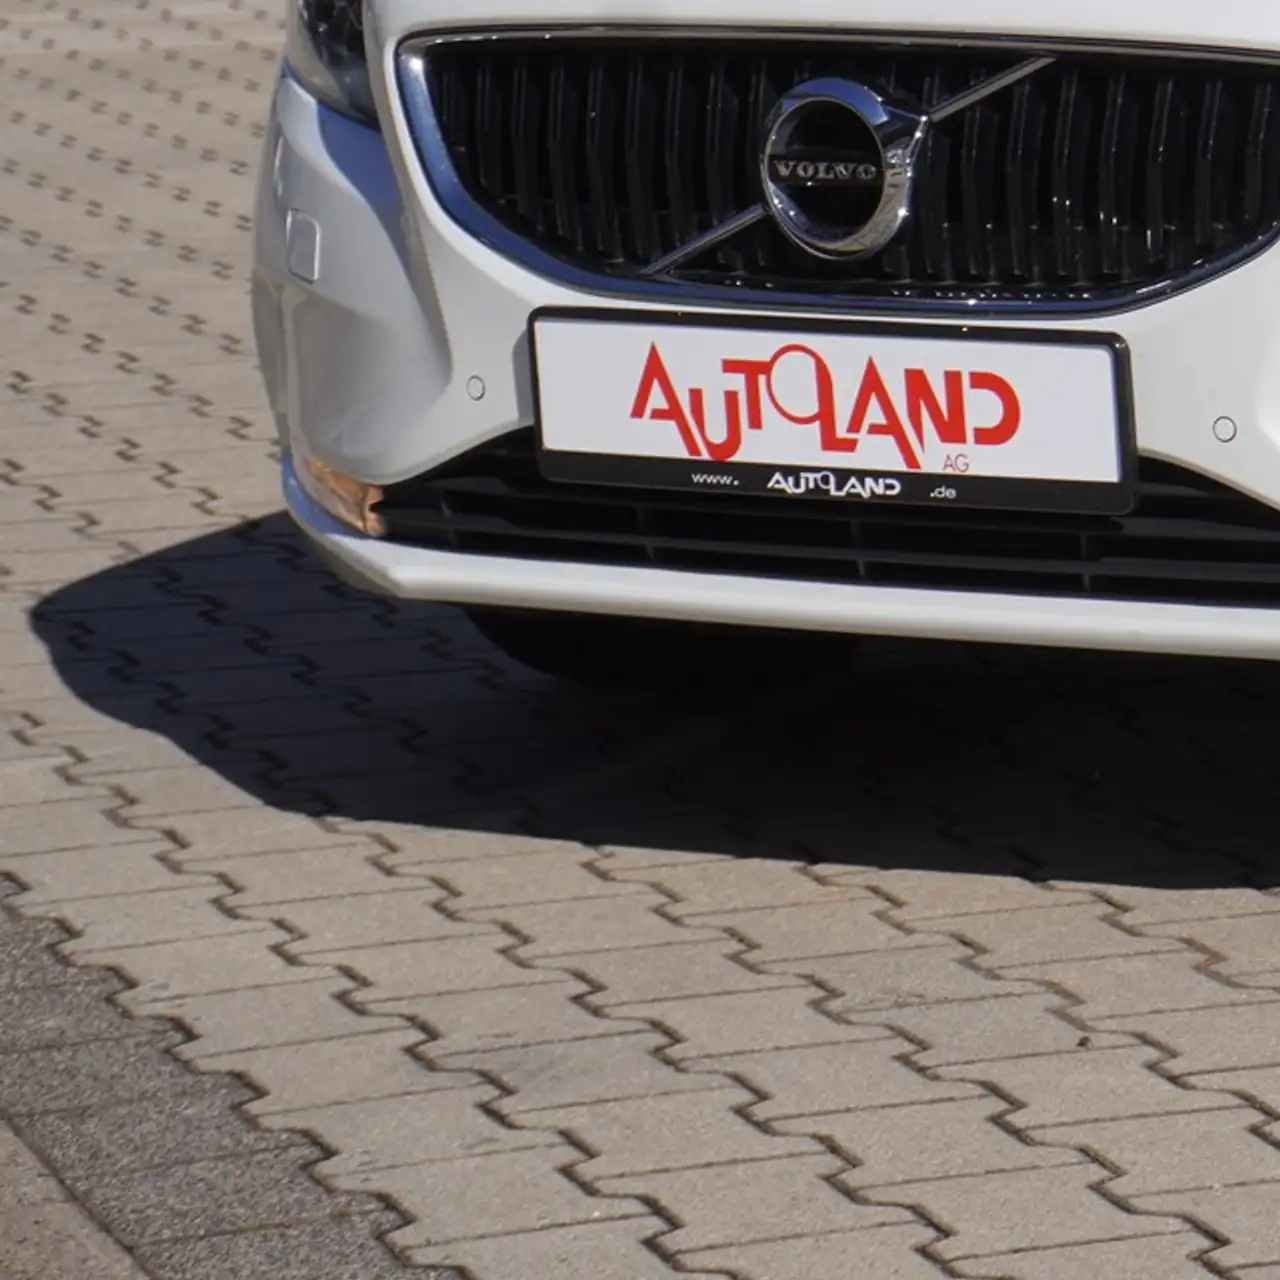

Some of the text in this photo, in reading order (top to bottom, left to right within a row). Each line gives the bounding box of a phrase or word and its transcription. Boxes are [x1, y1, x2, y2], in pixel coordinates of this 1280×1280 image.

[773, 158, 876, 180] VOLVO
[631, 341, 1021, 470] AUTOLAND
[942, 453, 970, 474] AG
[766, 471, 902, 499] AUTOLAND
[929, 485, 957, 500] .de
